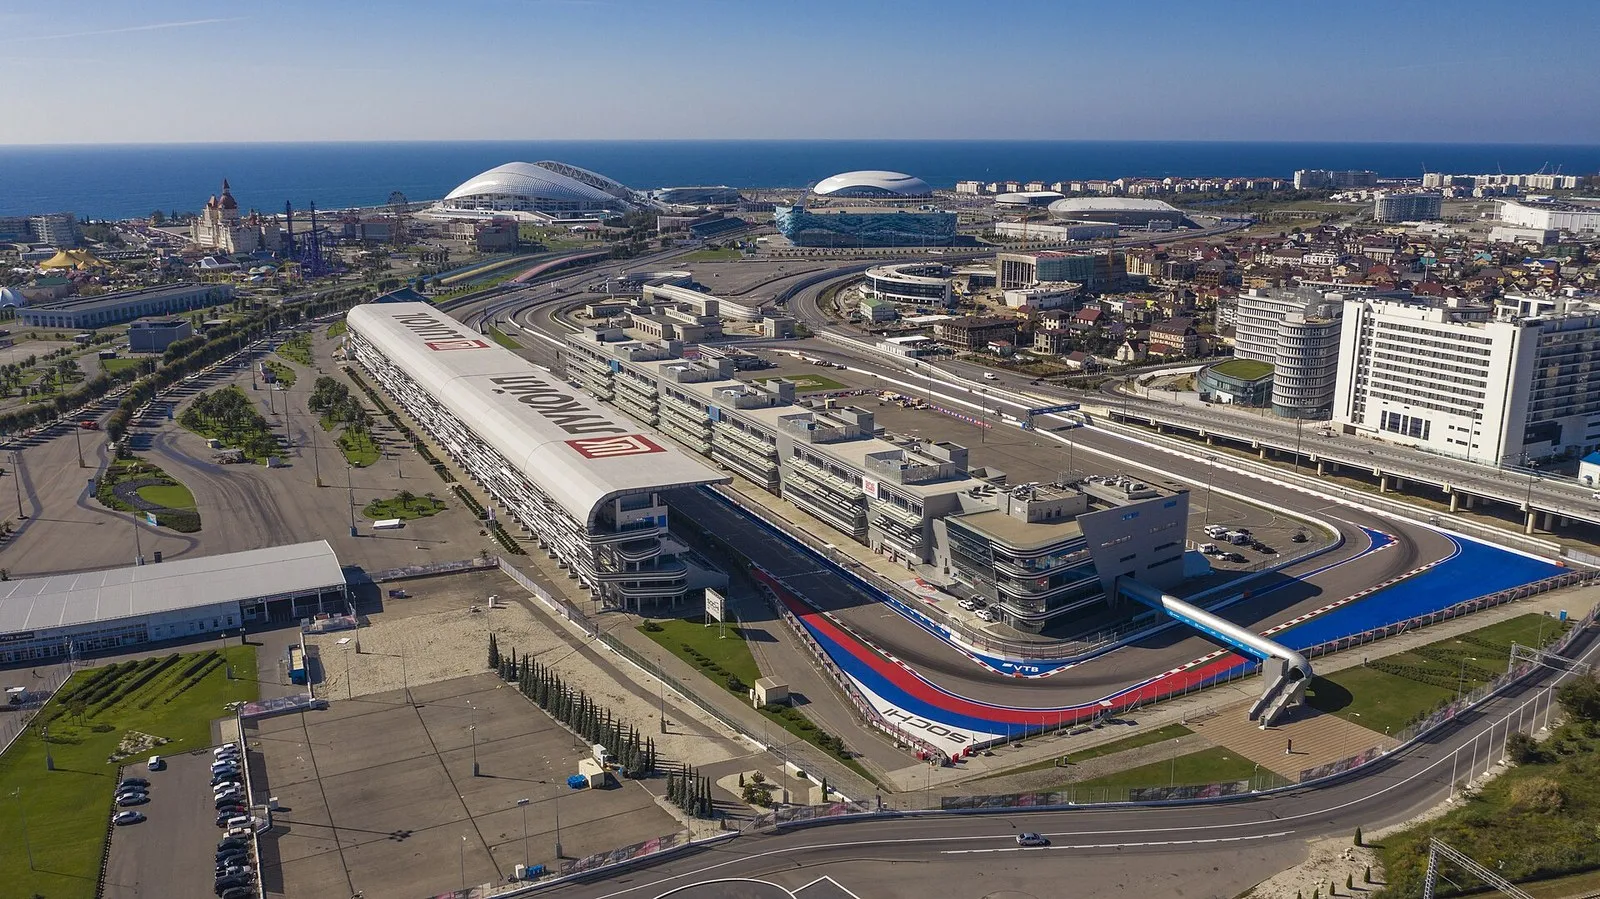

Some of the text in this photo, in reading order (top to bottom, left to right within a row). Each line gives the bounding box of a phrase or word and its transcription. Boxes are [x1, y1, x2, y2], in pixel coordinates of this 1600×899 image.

[391, 312, 466, 340] LUKOIL
[489, 375, 628, 435] ЛУКОЙЛ
[1013, 664, 1039, 673] VTB
[882, 708, 970, 744] SOCHI
